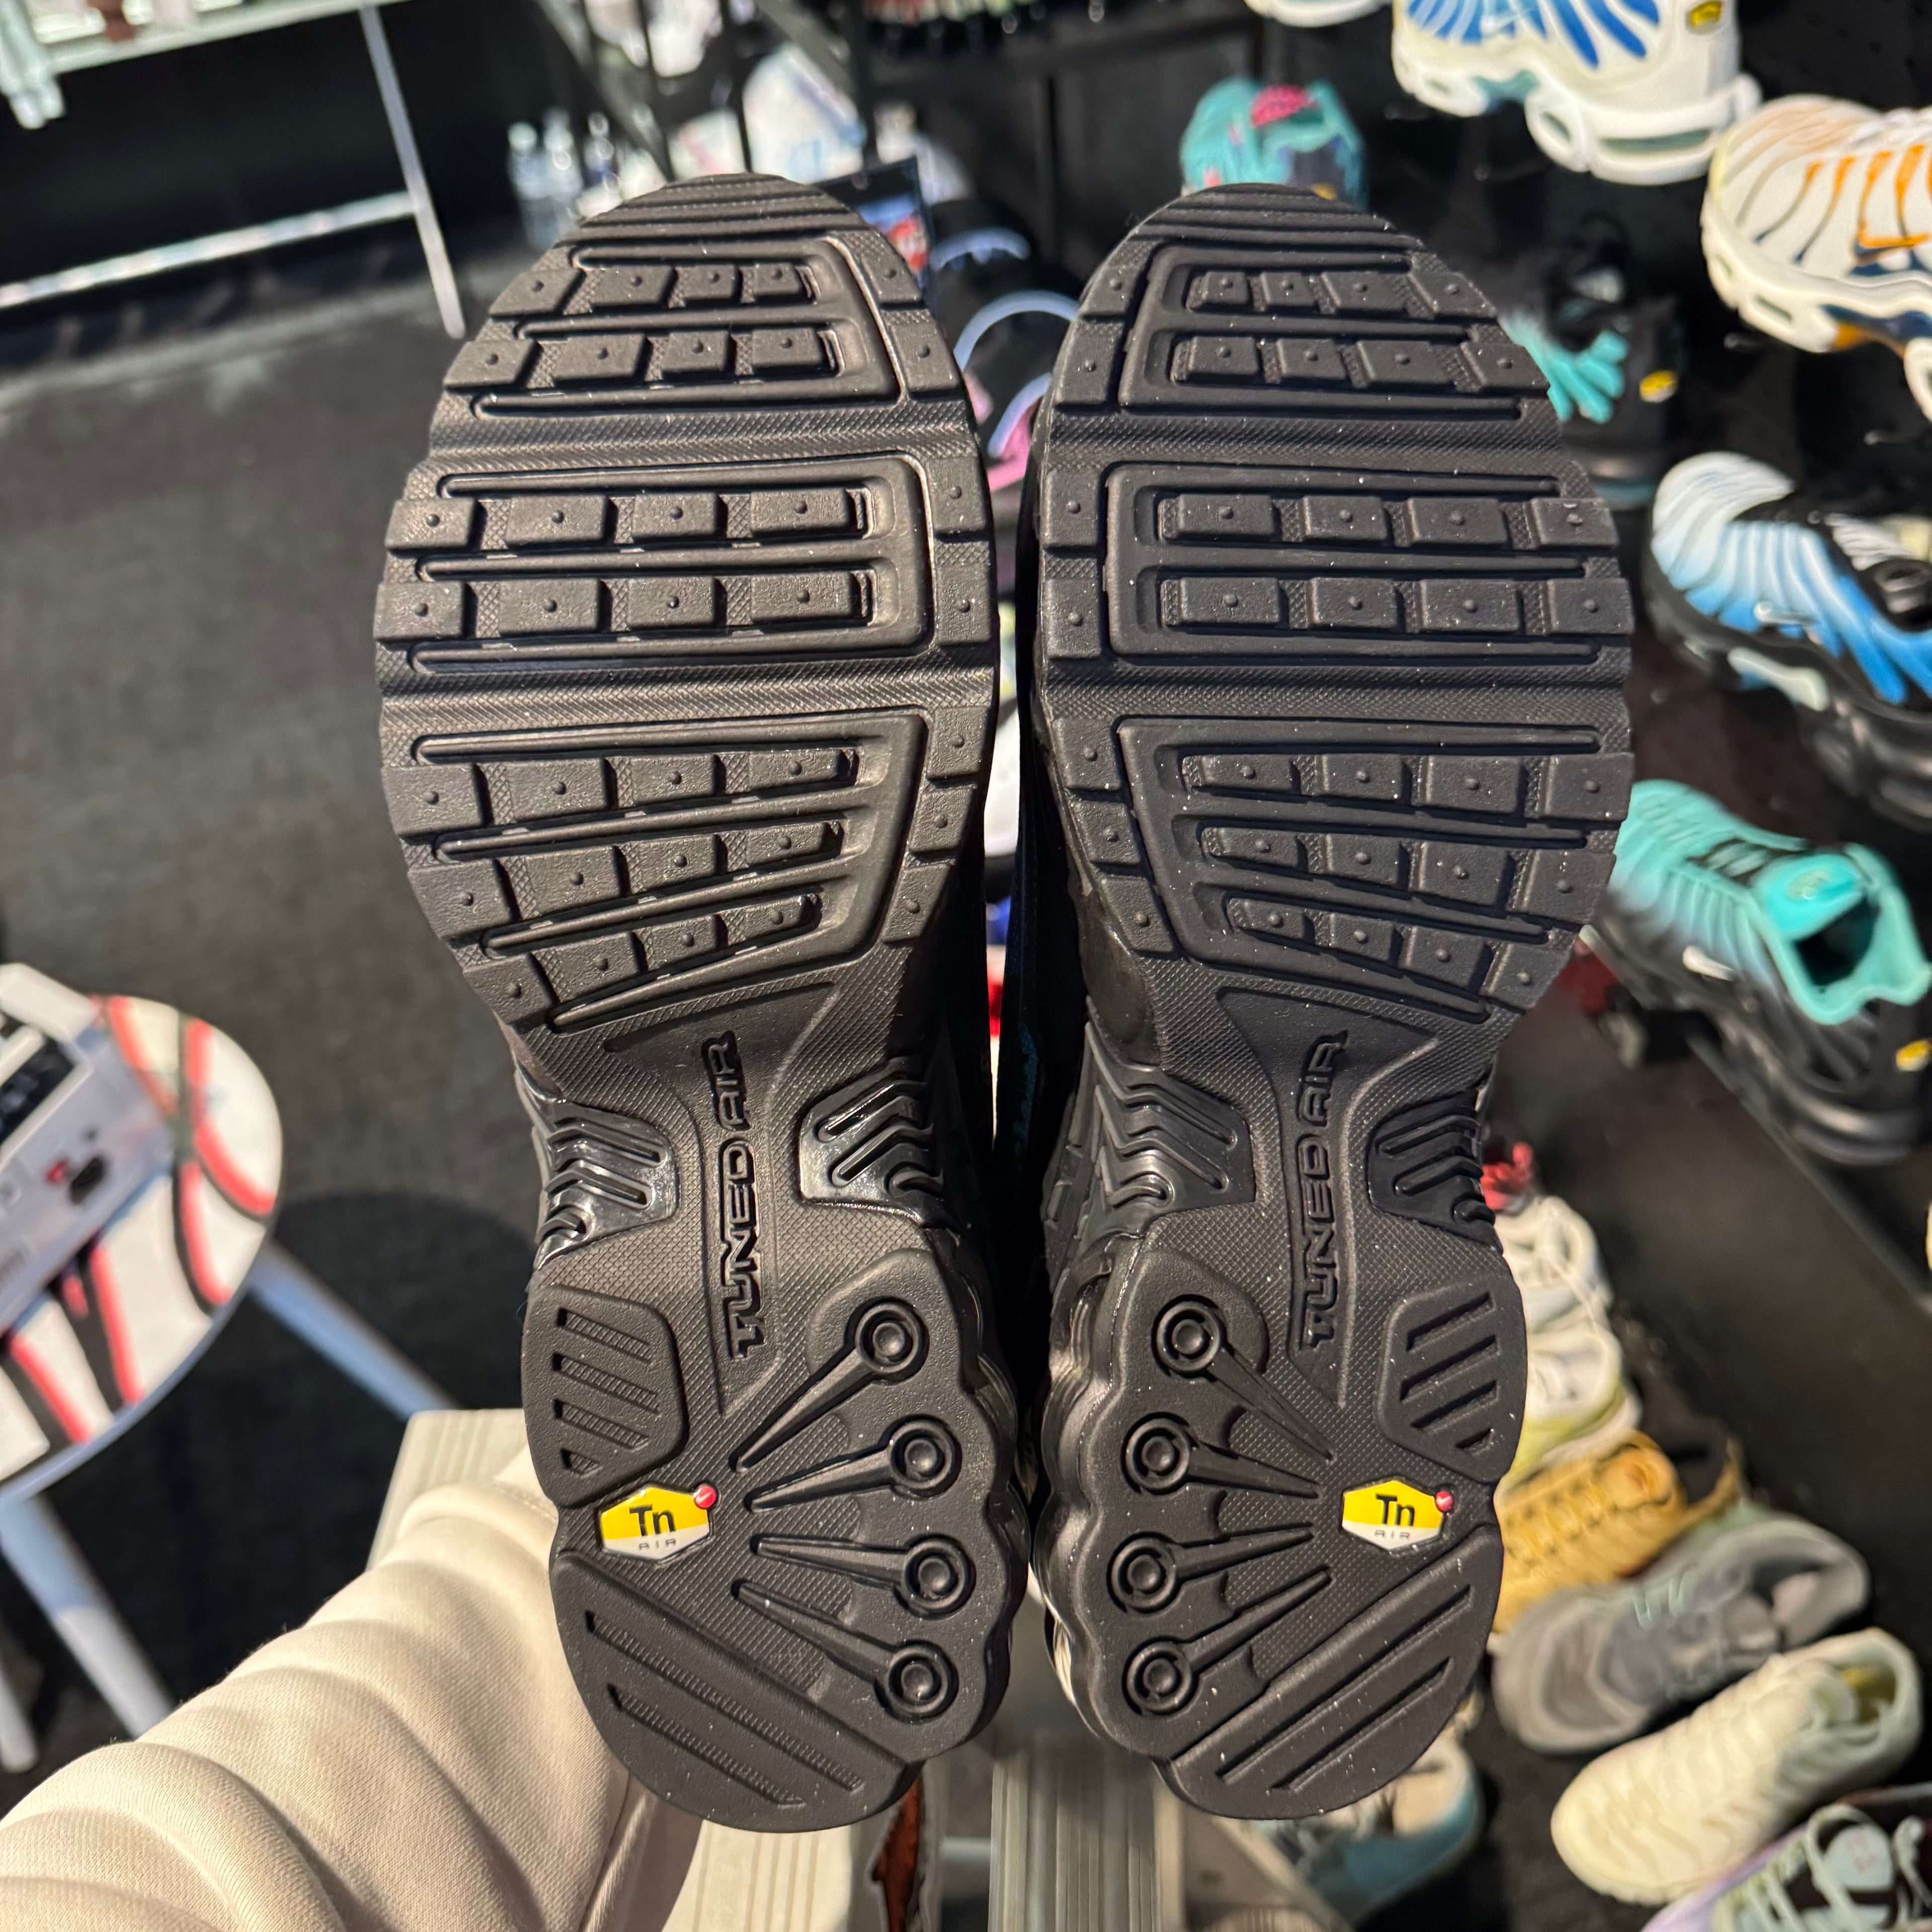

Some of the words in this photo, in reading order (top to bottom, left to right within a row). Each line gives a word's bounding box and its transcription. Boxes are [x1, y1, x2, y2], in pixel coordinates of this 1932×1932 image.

[704, 1033, 748, 1130] AIR
[1300, 1034, 1344, 1126] AIR
[720, 1138, 763, 1358] TUNED
[1300, 1136, 1336, 1347] TUNED
[629, 1504, 676, 1537] Tn
[1374, 1530, 1410, 1540] AIR
[1375, 1493, 1415, 1526] Tn
[638, 1538, 676, 1551] AIR
